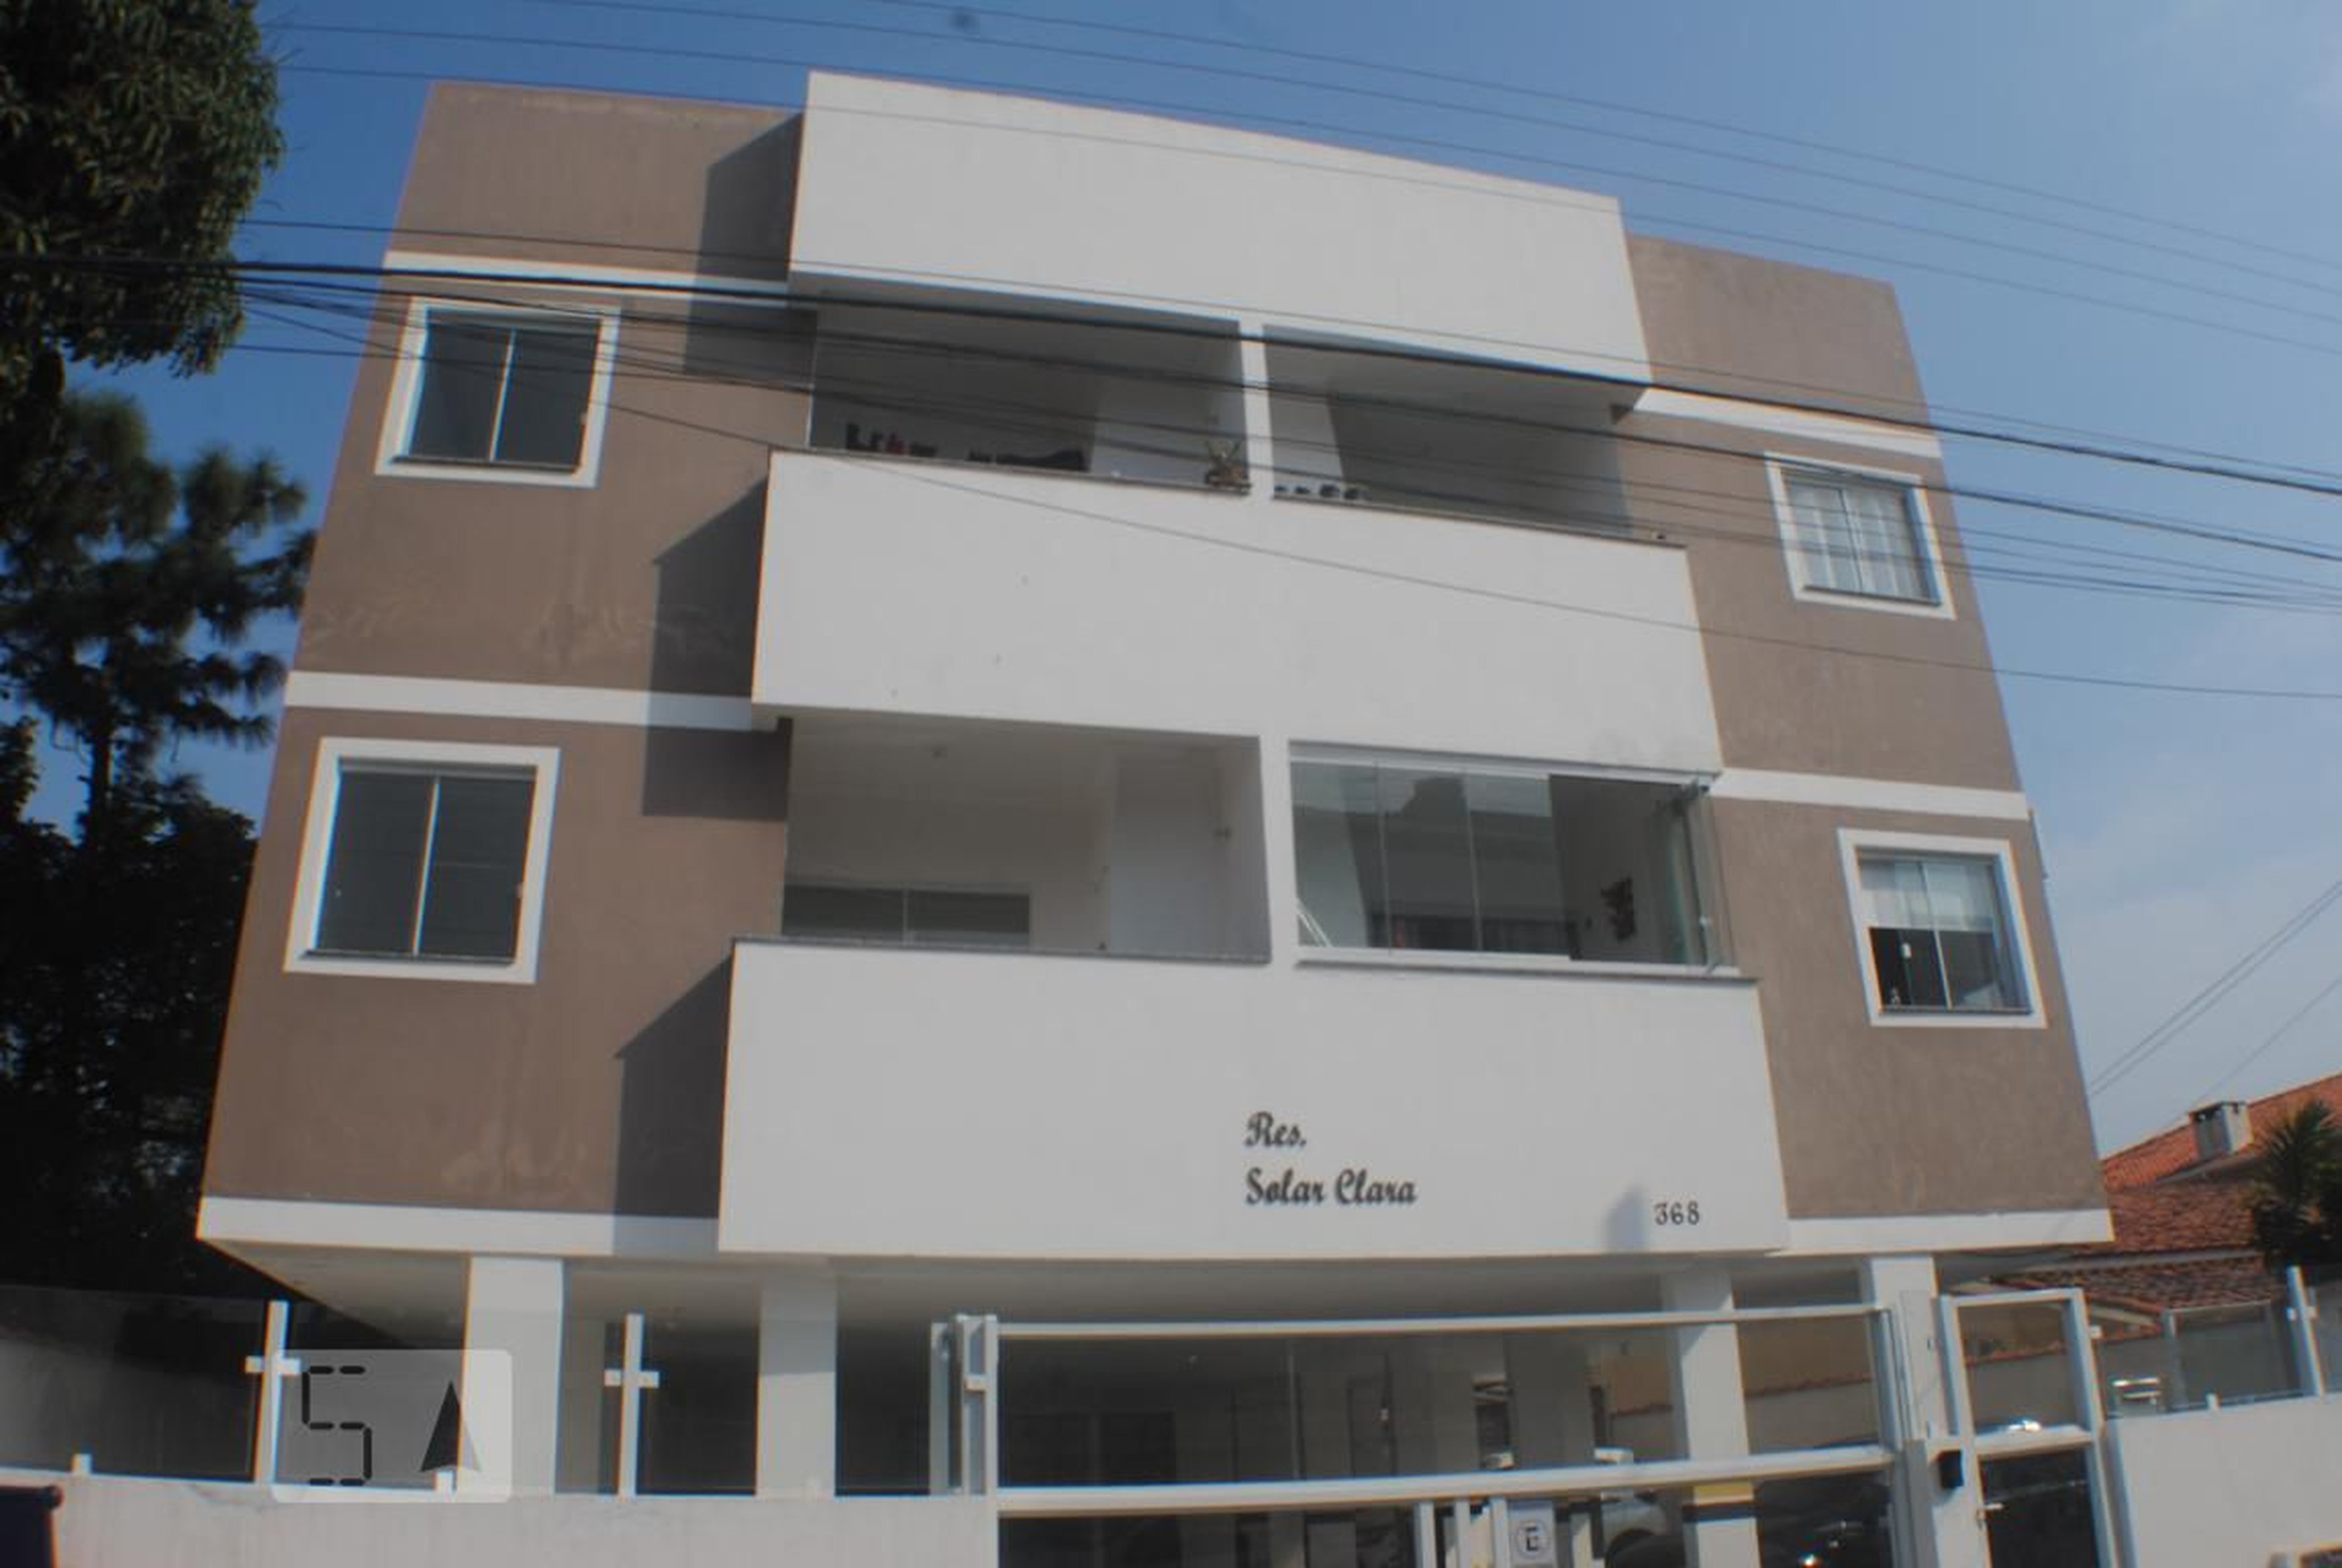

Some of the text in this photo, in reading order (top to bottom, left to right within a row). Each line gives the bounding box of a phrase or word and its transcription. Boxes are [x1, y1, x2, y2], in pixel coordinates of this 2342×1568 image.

[1245, 1111, 1306, 1147] Res.
[1246, 1167, 1416, 1205] Solar Clara
[1655, 1201, 1700, 1225] 368
